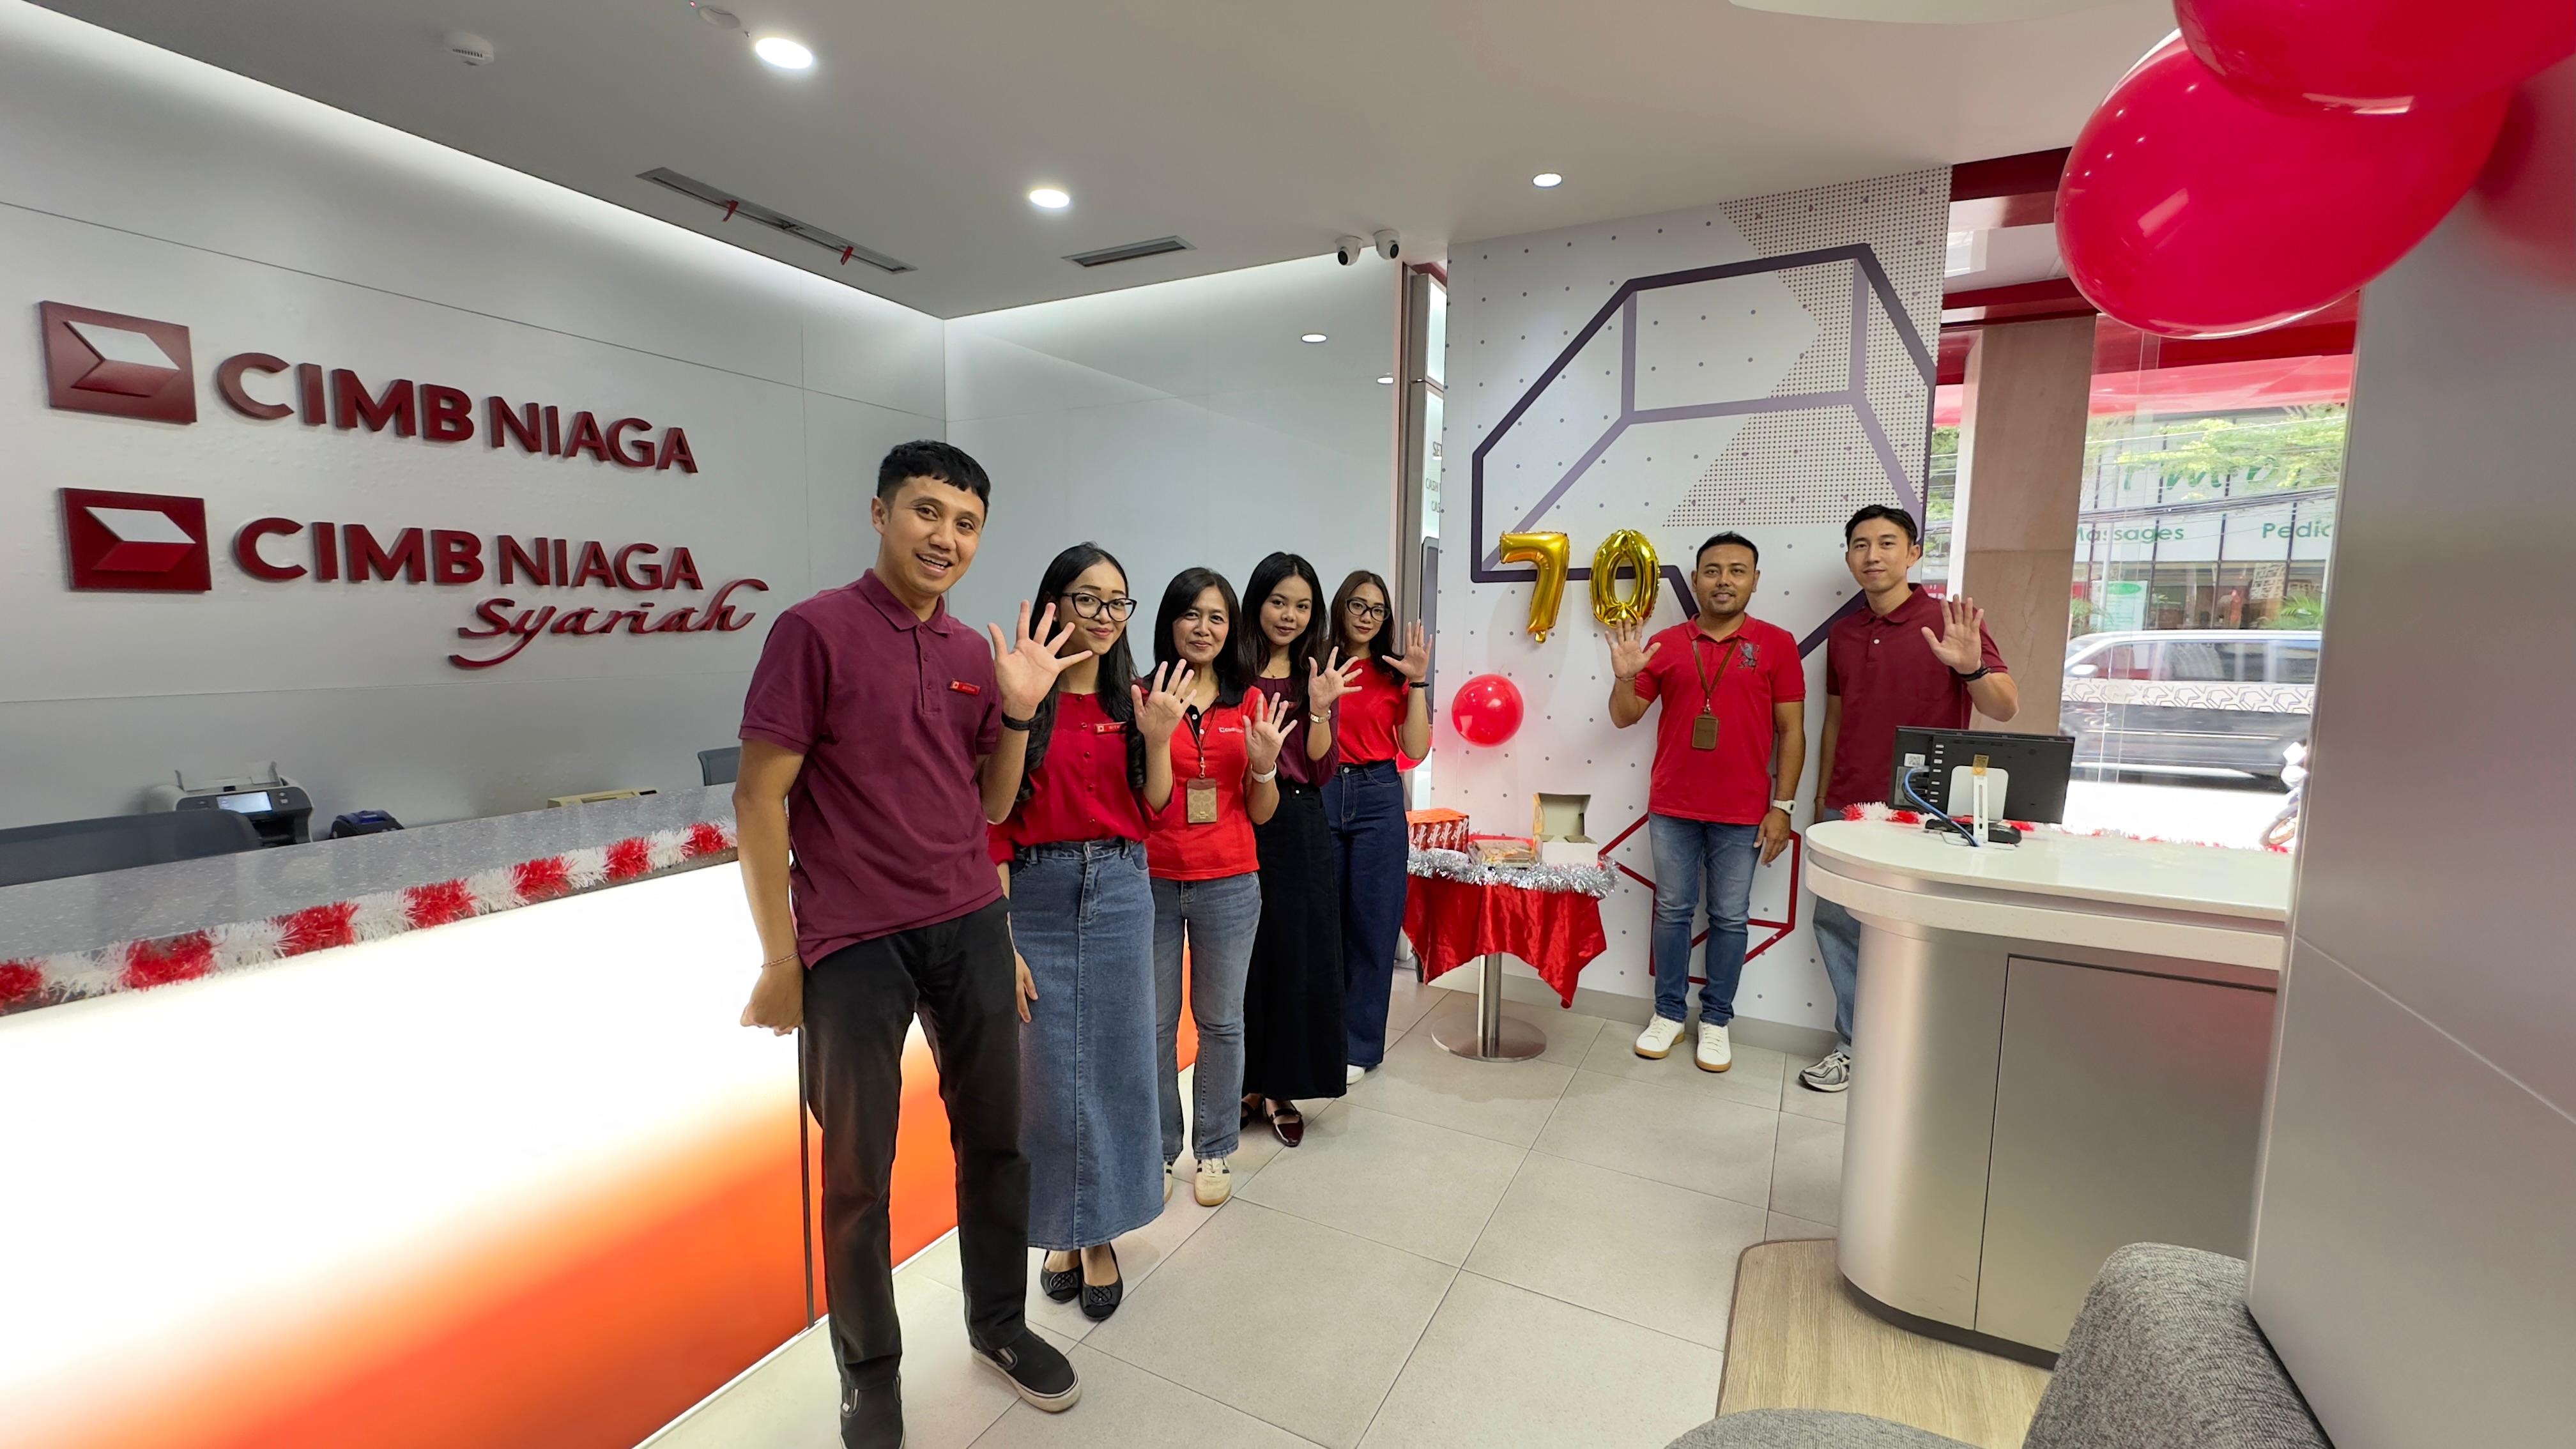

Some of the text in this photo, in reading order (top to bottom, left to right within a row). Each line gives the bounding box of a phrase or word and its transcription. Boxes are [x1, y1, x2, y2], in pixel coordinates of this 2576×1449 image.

[217, 353, 698, 473] CIMB NIAGA
[233, 518, 703, 590] CIMB NIAGA
[1499, 529, 1660, 643] 70
[449, 579, 769, 668] Syariah
